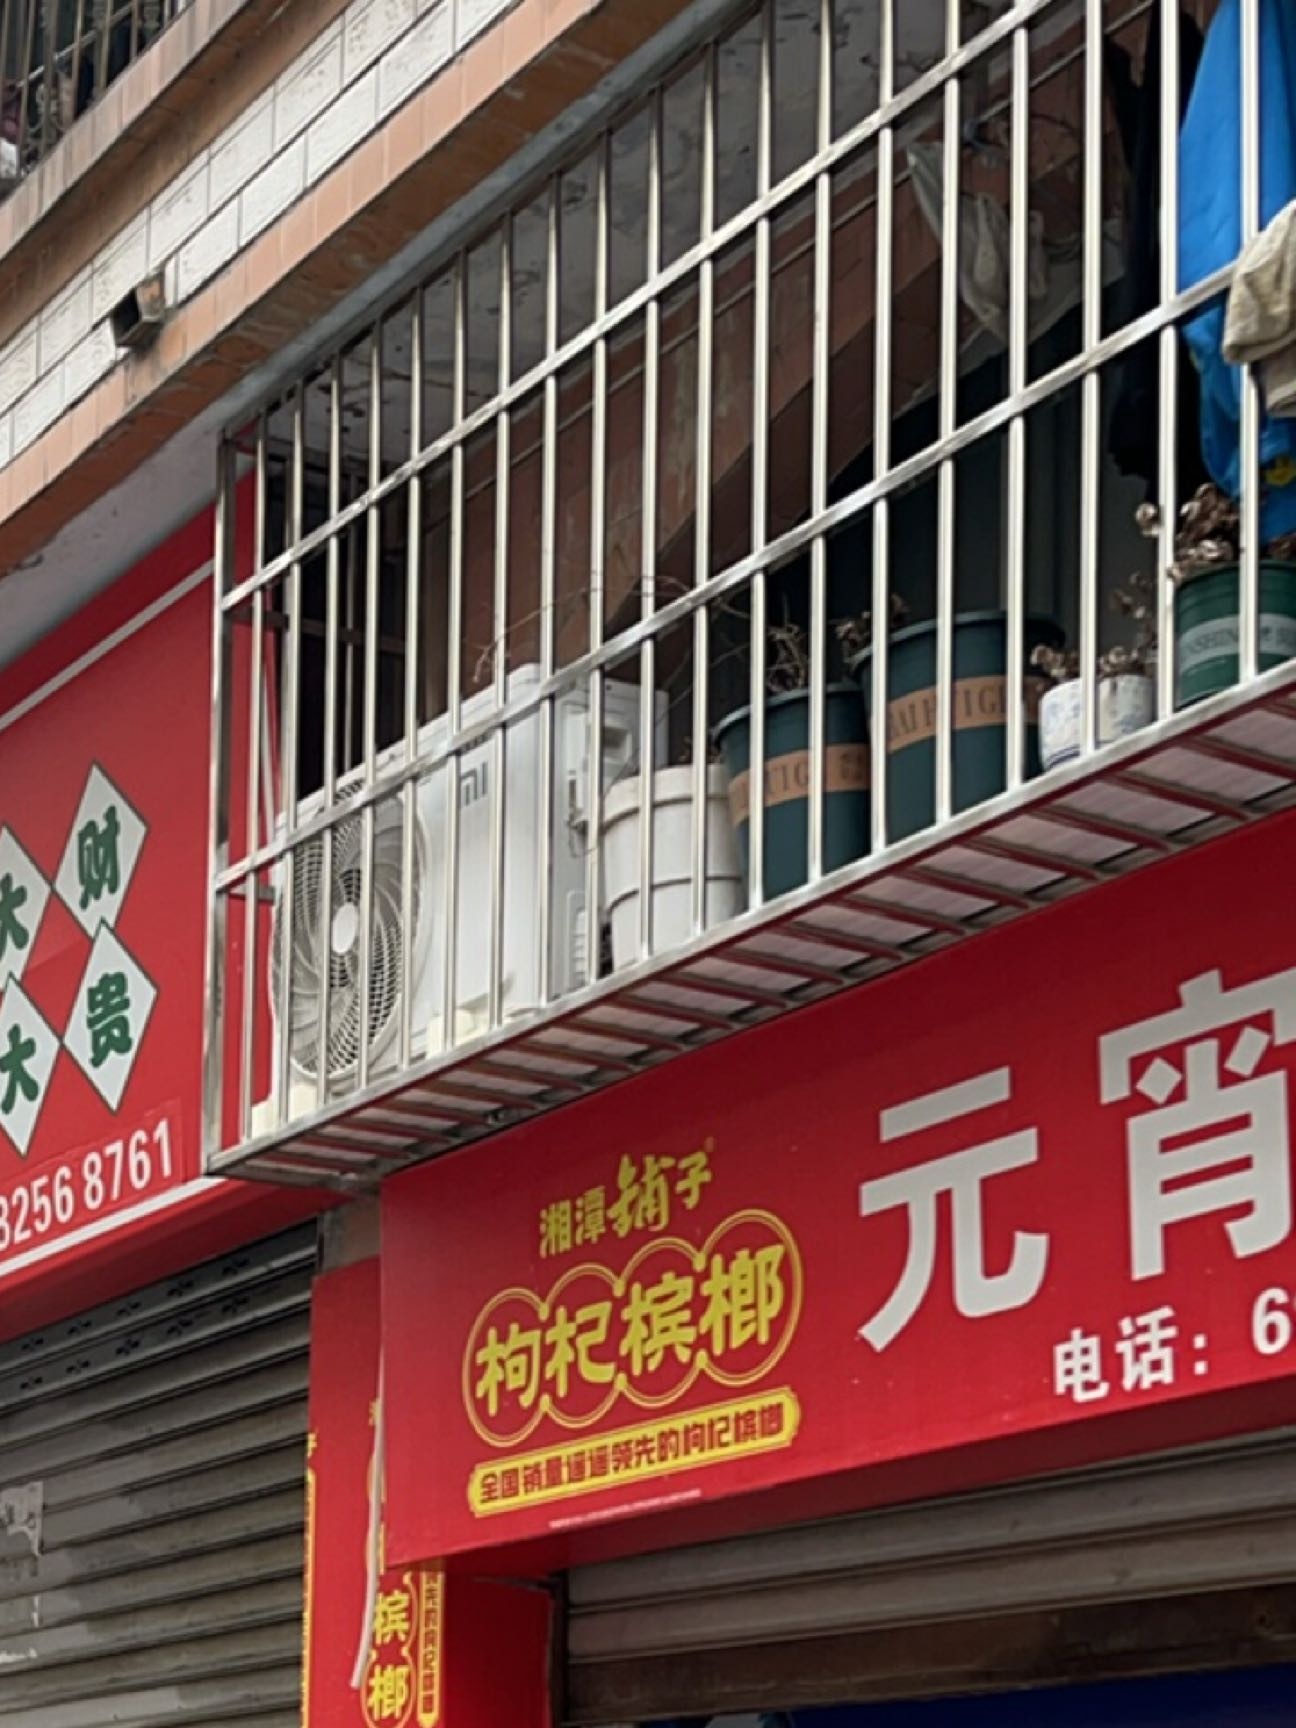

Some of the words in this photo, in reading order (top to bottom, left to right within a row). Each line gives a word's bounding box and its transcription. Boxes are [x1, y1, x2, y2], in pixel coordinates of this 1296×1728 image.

[82, 1116, 172, 1211] 8761
[539, 1151, 712, 1259] 湘潭铺子
[858, 966, 1296, 1353] 元宵
[474, 1244, 786, 1418] 枸杞槟榔
